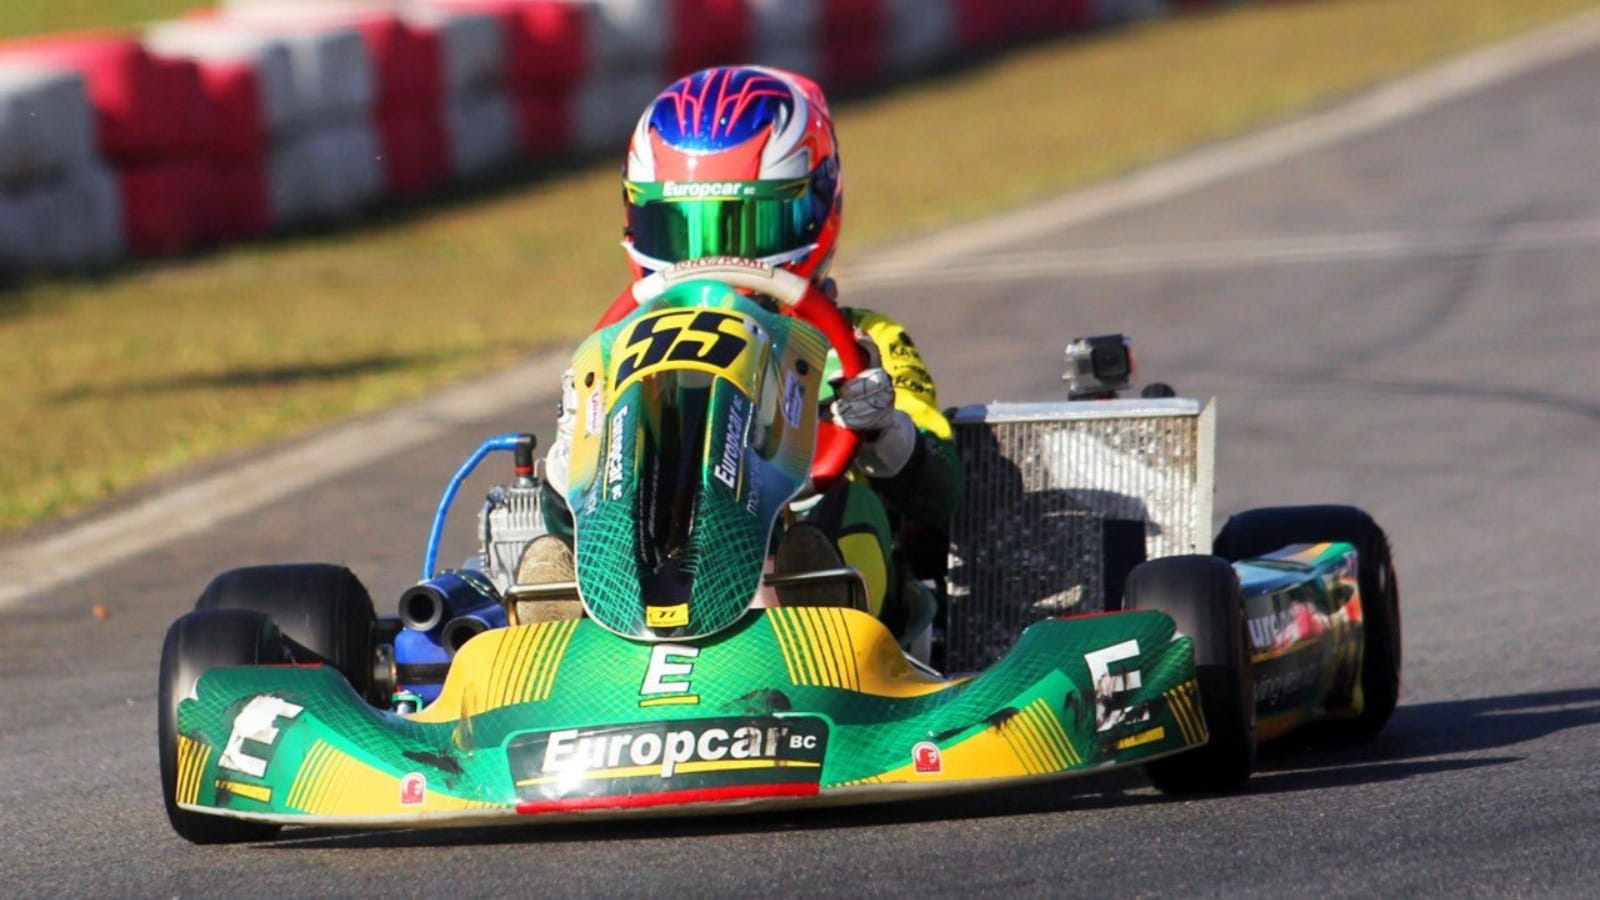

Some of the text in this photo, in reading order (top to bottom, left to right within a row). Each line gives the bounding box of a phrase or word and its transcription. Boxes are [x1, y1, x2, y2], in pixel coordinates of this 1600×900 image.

[662, 181, 742, 199] Europcar
[615, 310, 747, 391] 55
[714, 405, 743, 489] Europcar
[640, 643, 699, 696] E
[1084, 639, 1150, 732] E
[217, 694, 304, 778] E
[541, 727, 817, 778] Europcar BC
